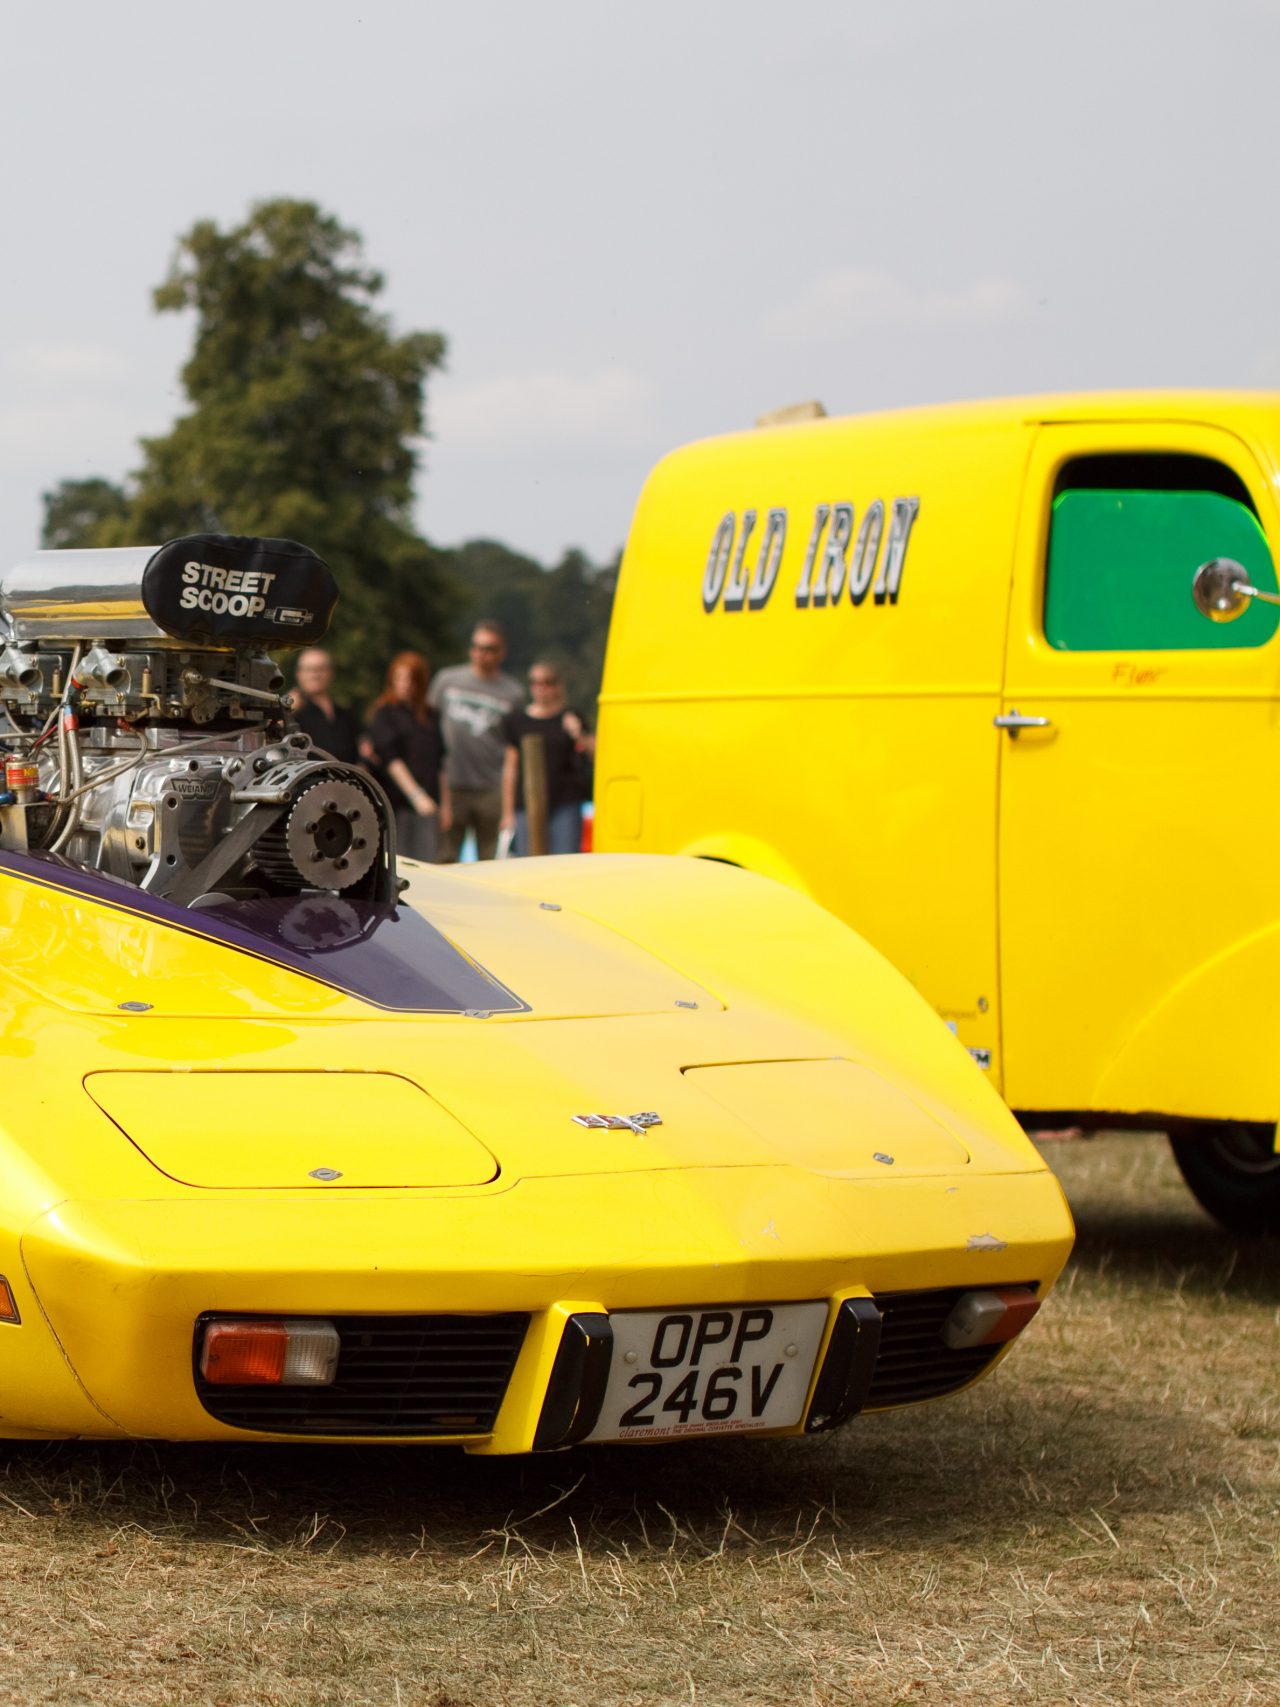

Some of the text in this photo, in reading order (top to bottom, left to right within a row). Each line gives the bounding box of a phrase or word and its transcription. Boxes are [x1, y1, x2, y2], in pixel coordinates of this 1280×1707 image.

[181, 561, 276, 594] STREET
[702, 496, 920, 615] OLD IRON
[179, 586, 266, 618] SCOOP
[650, 1309, 774, 1368] OPP
[619, 1363, 785, 1427] 246V
[619, 1425, 671, 1438] claremont
